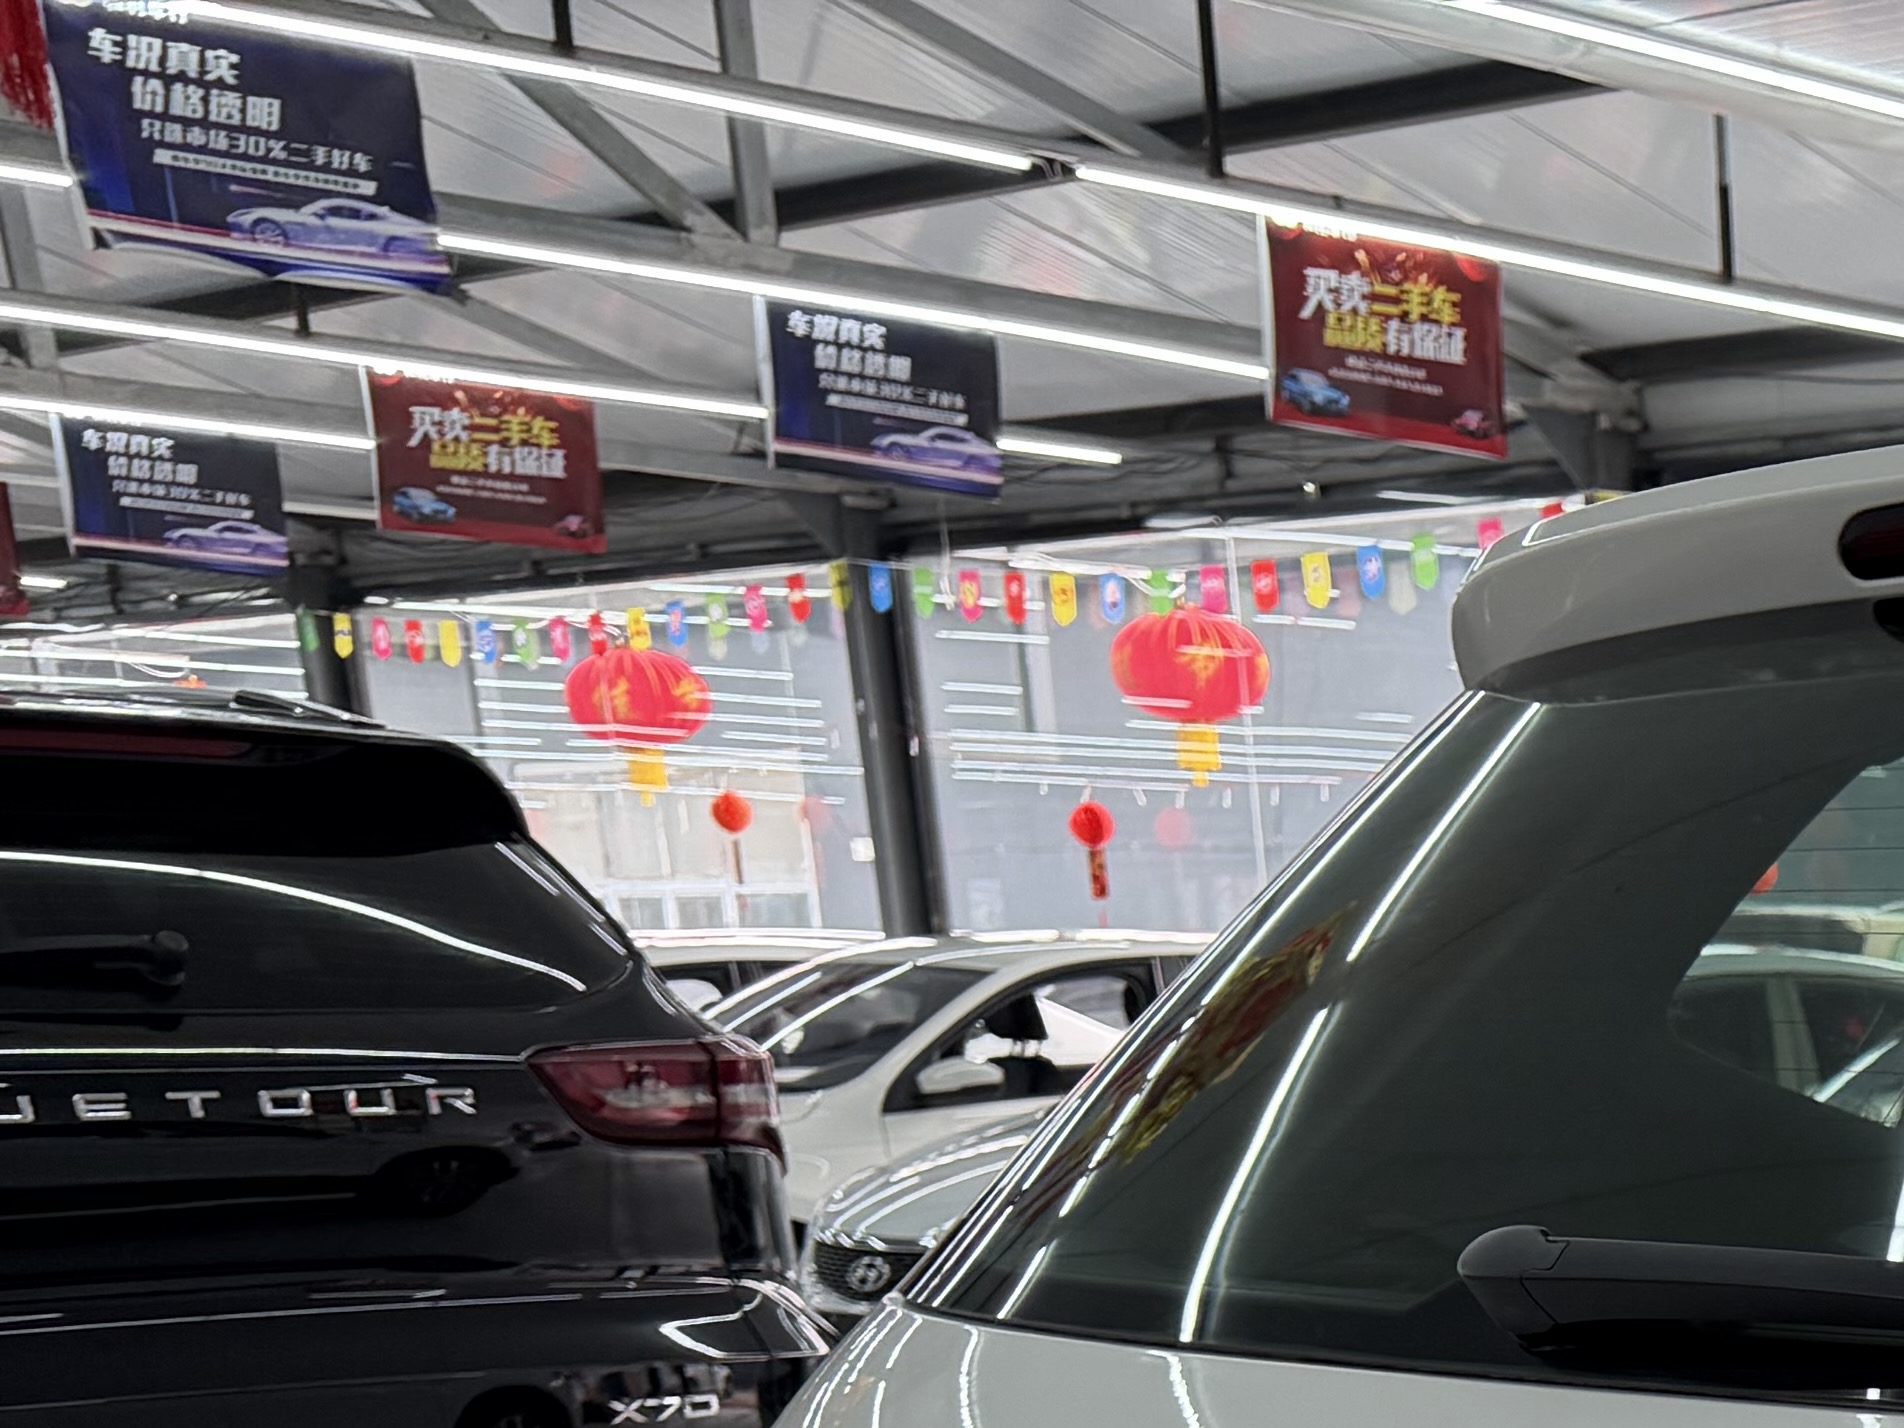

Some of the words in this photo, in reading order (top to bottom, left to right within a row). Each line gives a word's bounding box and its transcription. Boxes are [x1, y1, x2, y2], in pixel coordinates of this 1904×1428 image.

[87, 28, 241, 85] 车况真实
[131, 76, 283, 132] 价格透明
[1298, 267, 1462, 324] 买卖二手车
[0, 1086, 477, 1124] JETOUR
[608, 1393, 720, 1425] X70
